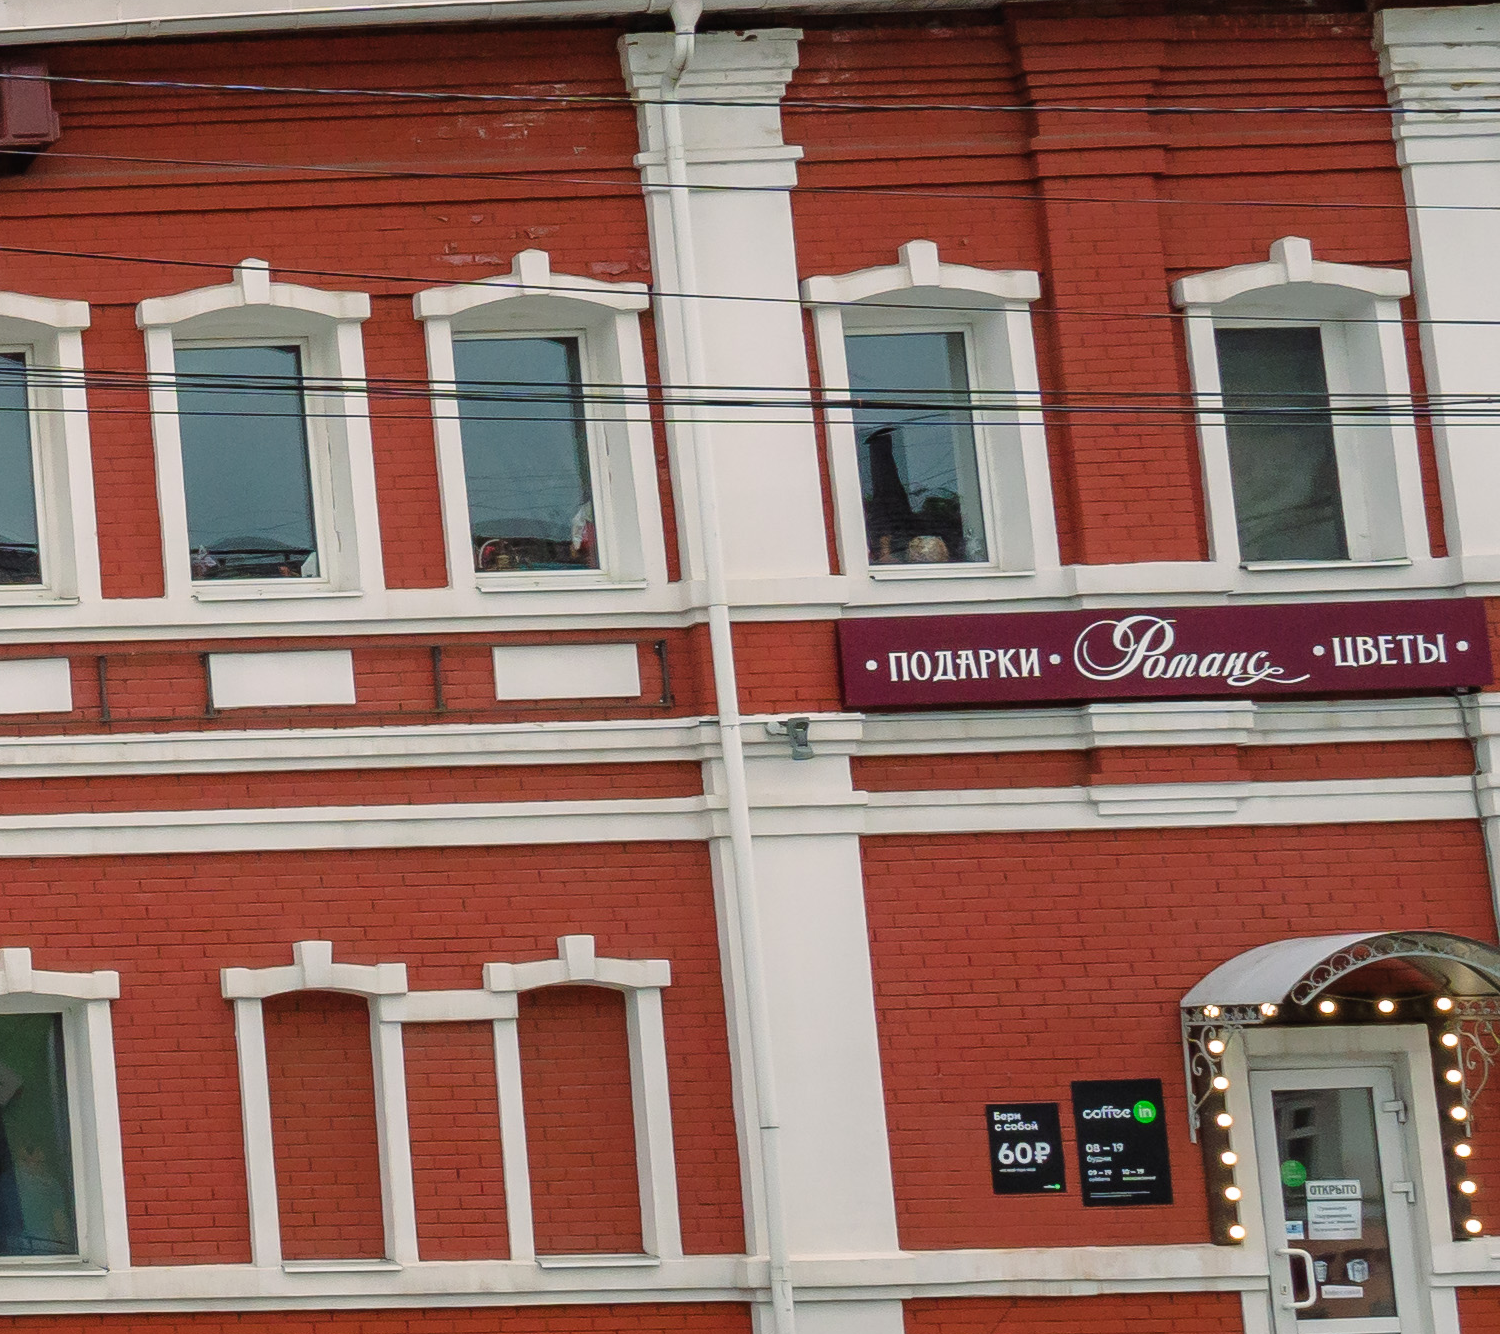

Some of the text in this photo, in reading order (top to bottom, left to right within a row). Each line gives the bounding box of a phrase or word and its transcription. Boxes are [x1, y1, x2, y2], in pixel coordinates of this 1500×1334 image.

[888, 615, 1449, 686] ПОДАРКИ Романс ЦВЕТЫ
[993, 1111, 1021, 1122] Бери
[1082, 1105, 1153, 1119] coffee in
[1004, 1121, 1039, 1131] собой
[1309, 1184, 1358, 1195] ОТКРЫТО
